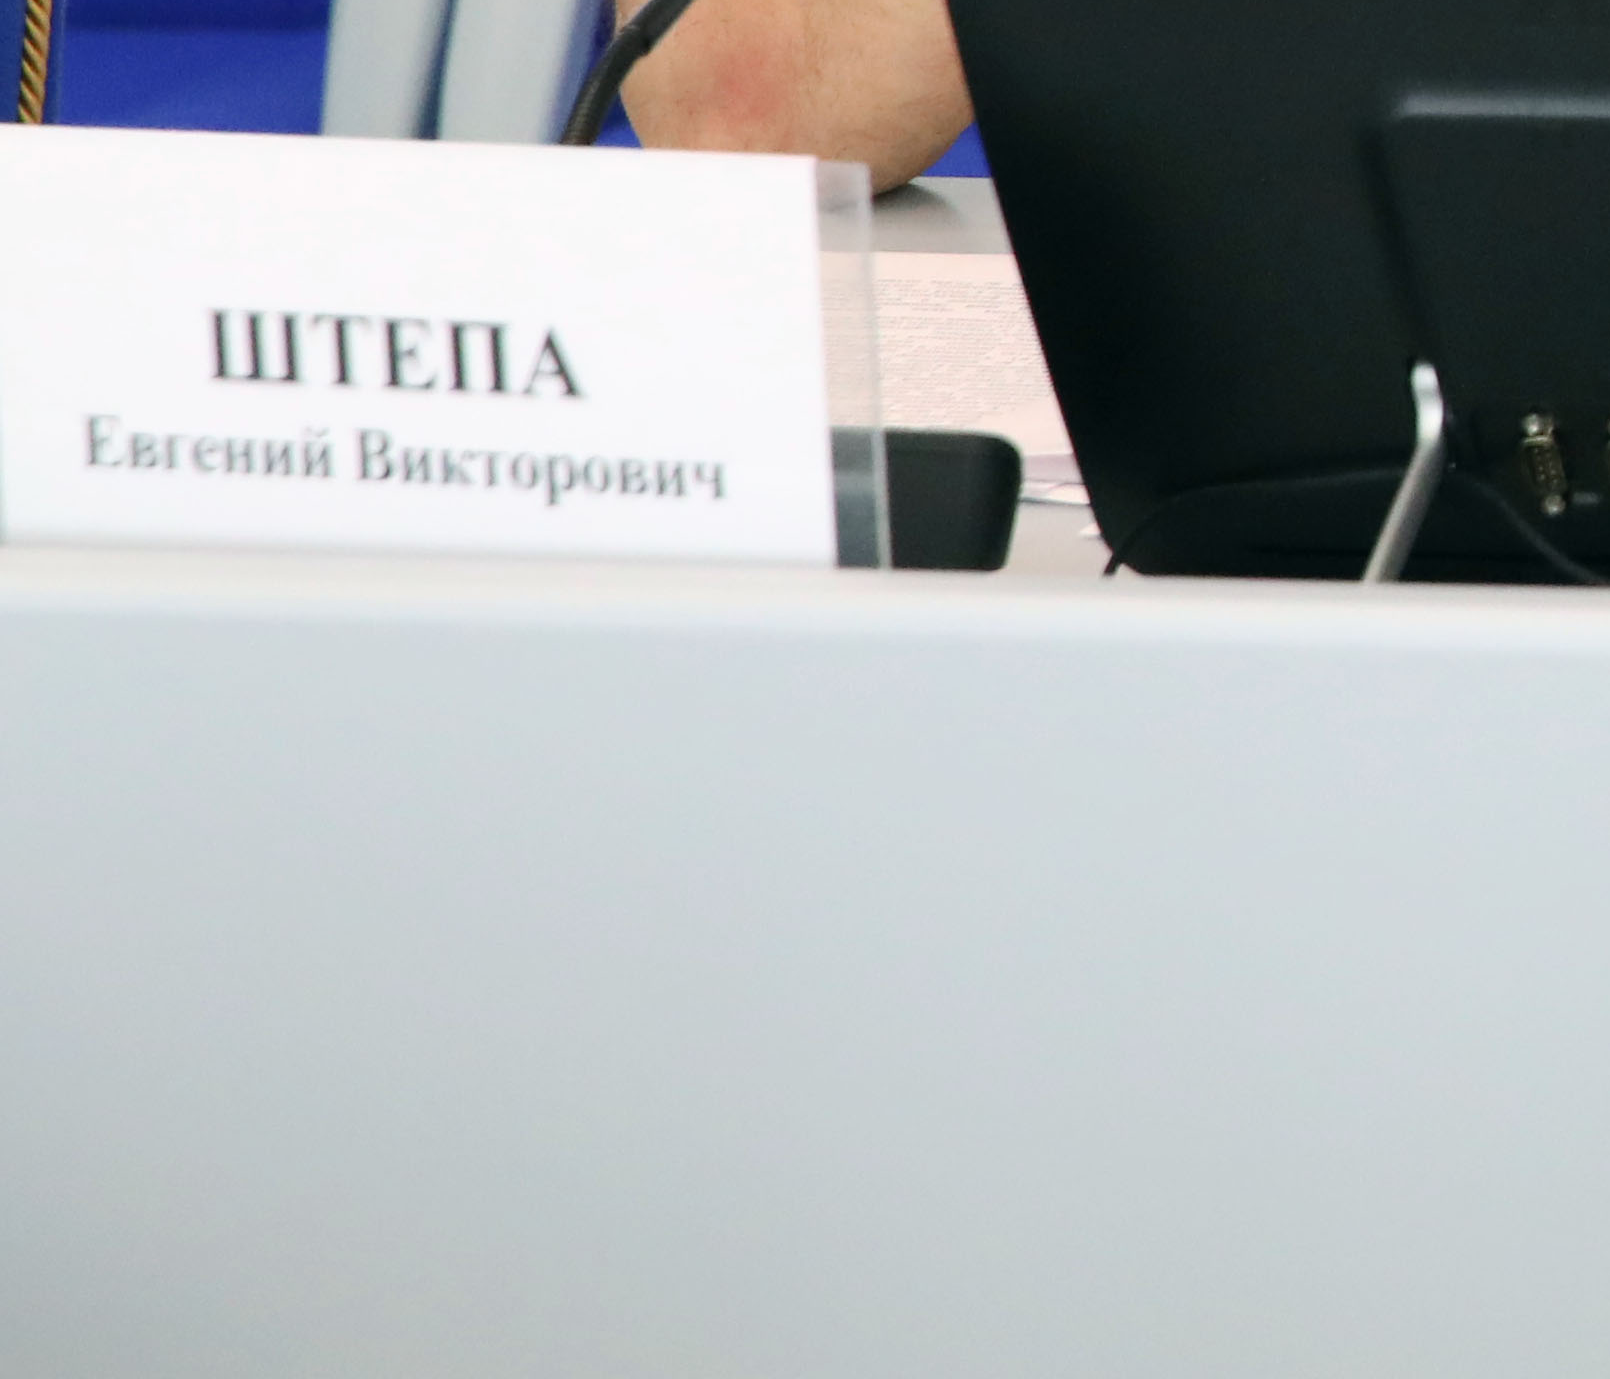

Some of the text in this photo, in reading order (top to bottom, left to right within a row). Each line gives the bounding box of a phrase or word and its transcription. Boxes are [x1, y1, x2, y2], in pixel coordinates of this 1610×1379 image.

[209, 308, 586, 399] ШТЕПА
[83, 413, 728, 510] Евгений Викторович
